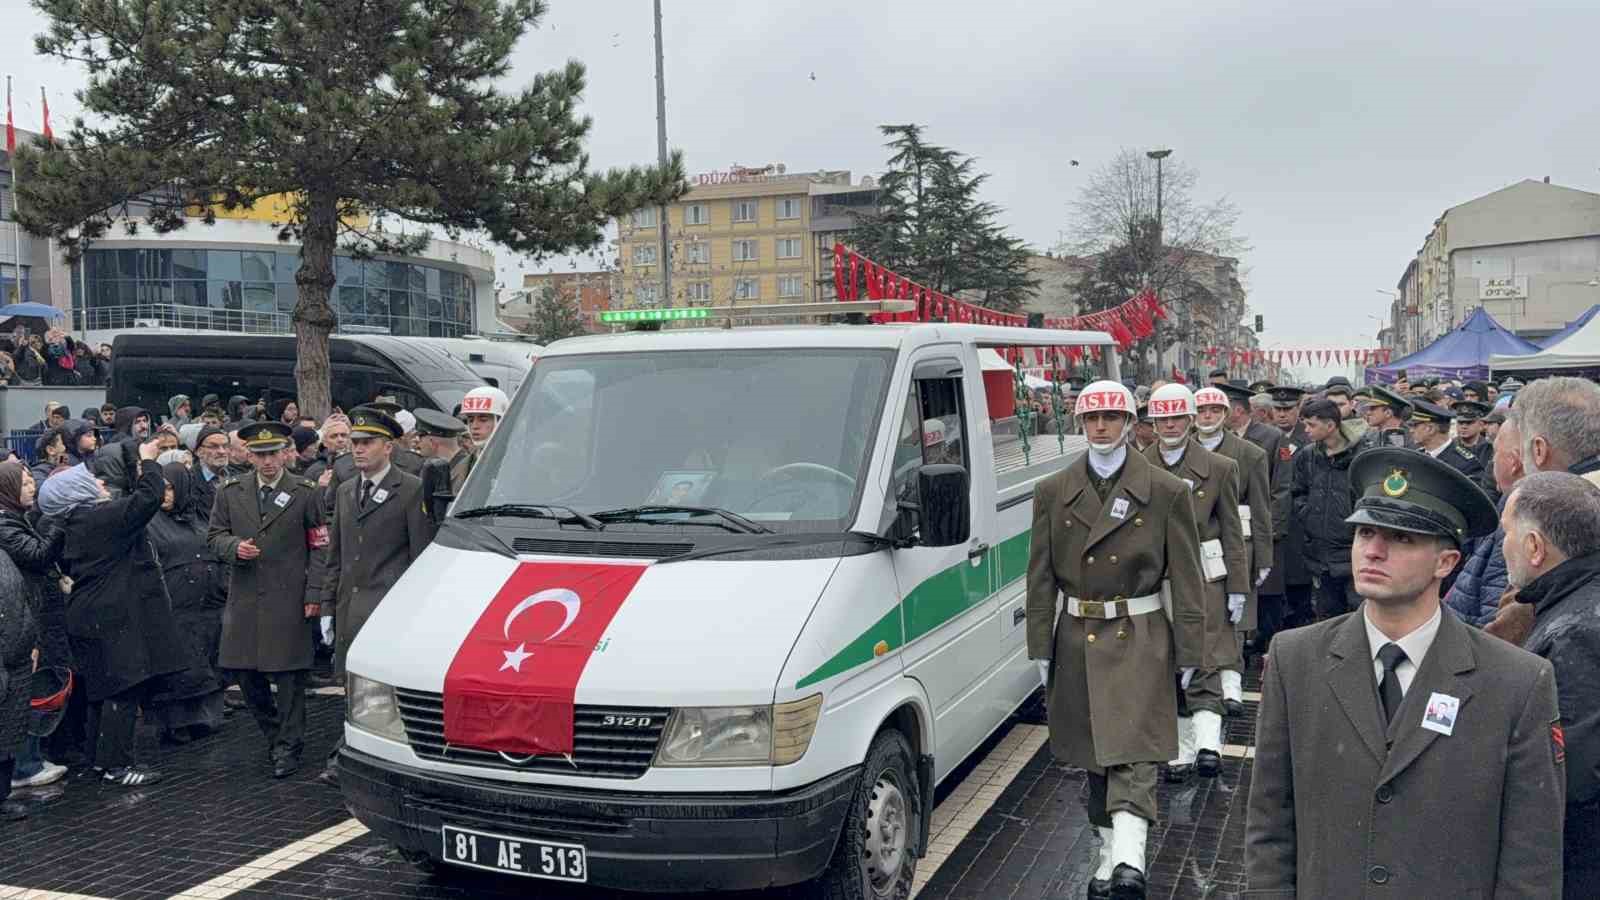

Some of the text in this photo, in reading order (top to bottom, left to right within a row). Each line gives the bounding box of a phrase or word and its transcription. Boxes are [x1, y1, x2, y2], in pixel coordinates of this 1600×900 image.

[455, 832, 583, 877] 81 AE 513
